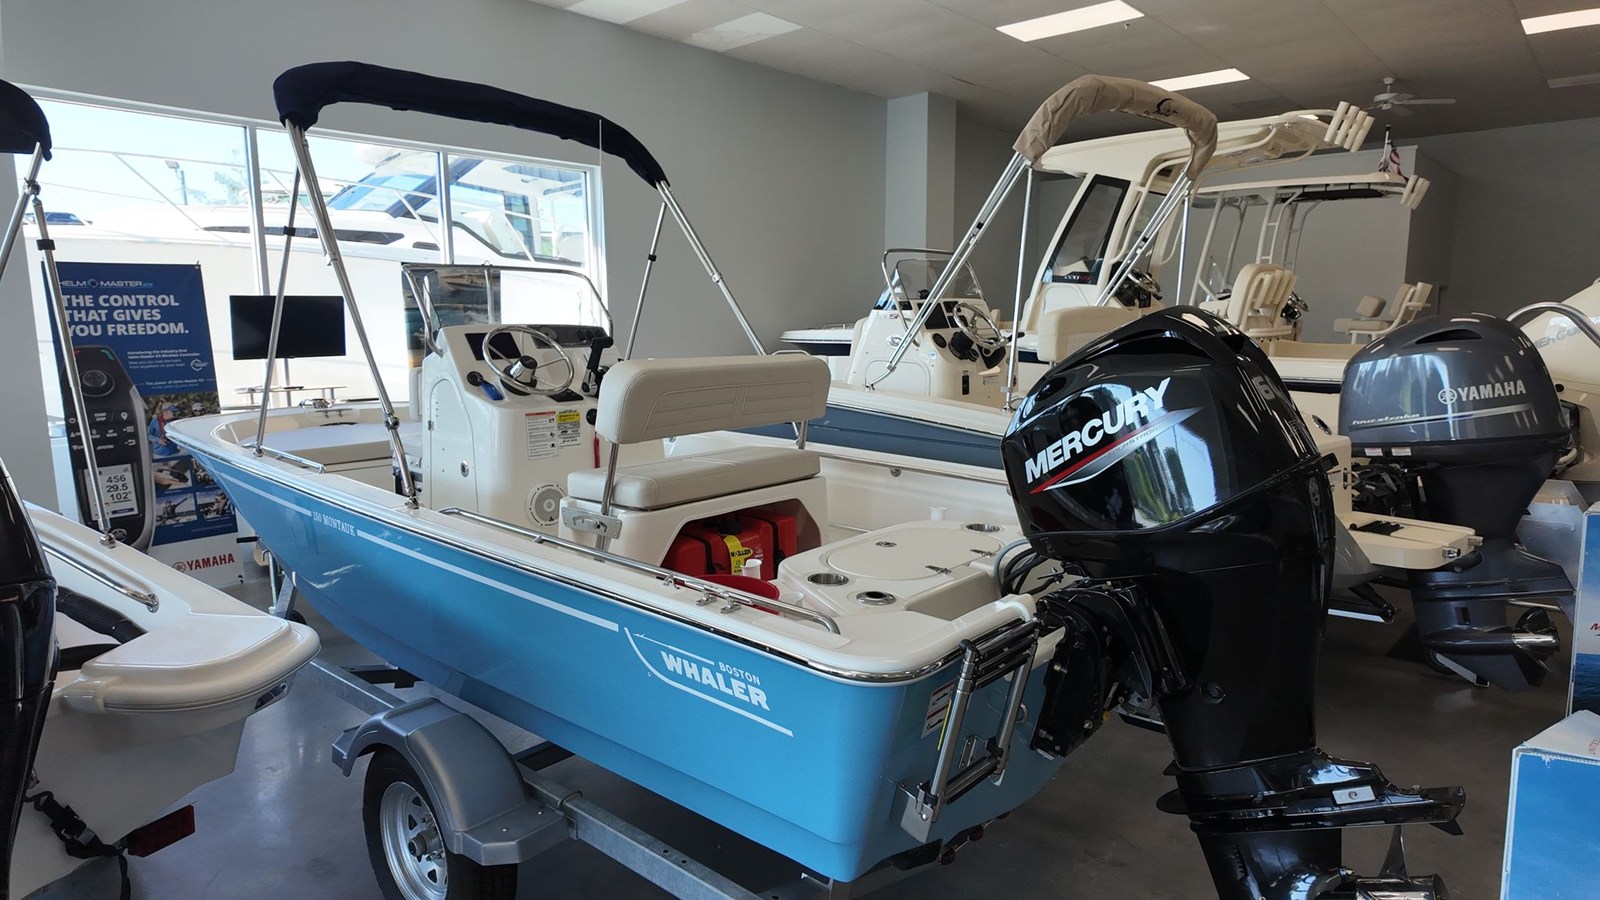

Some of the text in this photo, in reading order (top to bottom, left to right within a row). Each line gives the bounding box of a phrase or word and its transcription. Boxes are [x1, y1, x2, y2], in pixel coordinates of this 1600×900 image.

[62, 294, 180, 307] THE CONTROL
[65, 308, 162, 322] THAT GIVES
[68, 322, 190, 337] YOU FREEDOM.
[1458, 380, 1527, 402] YAMAHA
[1024, 376, 1171, 485] MERCURY
[106, 474, 126, 483] 456
[106, 483, 129, 493] 29.5
[322, 514, 356, 536] MONTAUK
[186, 553, 235, 571] YAMAHA
[660, 650, 770, 711] WHALER
[718, 662, 760, 686] BOSTON
